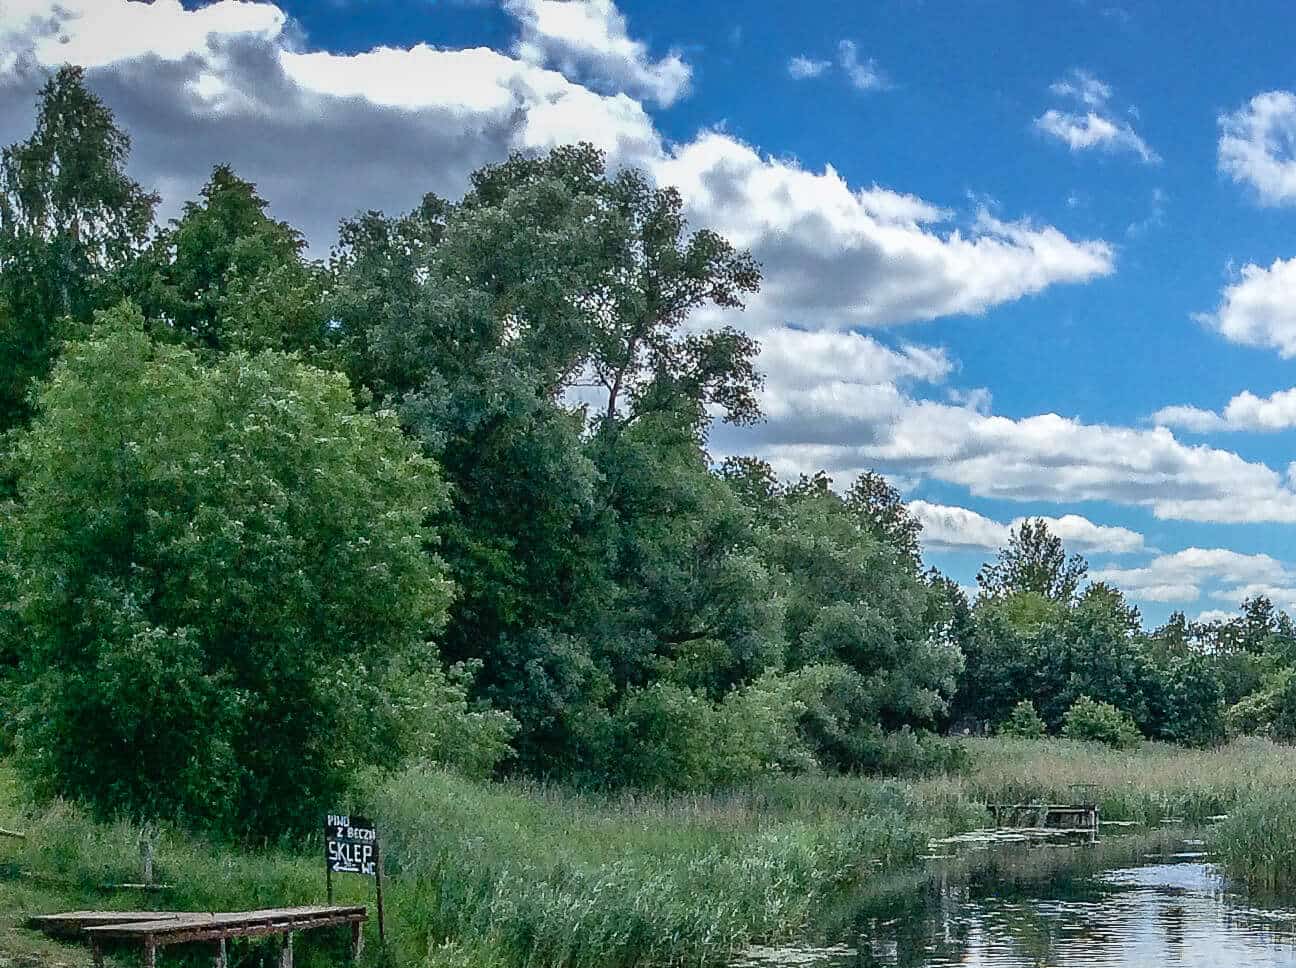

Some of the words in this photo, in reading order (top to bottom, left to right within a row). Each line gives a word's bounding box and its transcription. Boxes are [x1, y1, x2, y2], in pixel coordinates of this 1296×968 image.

[337, 827, 344, 838] Z
[328, 841, 373, 865] SKLEP
[361, 862, 376, 875] WC
